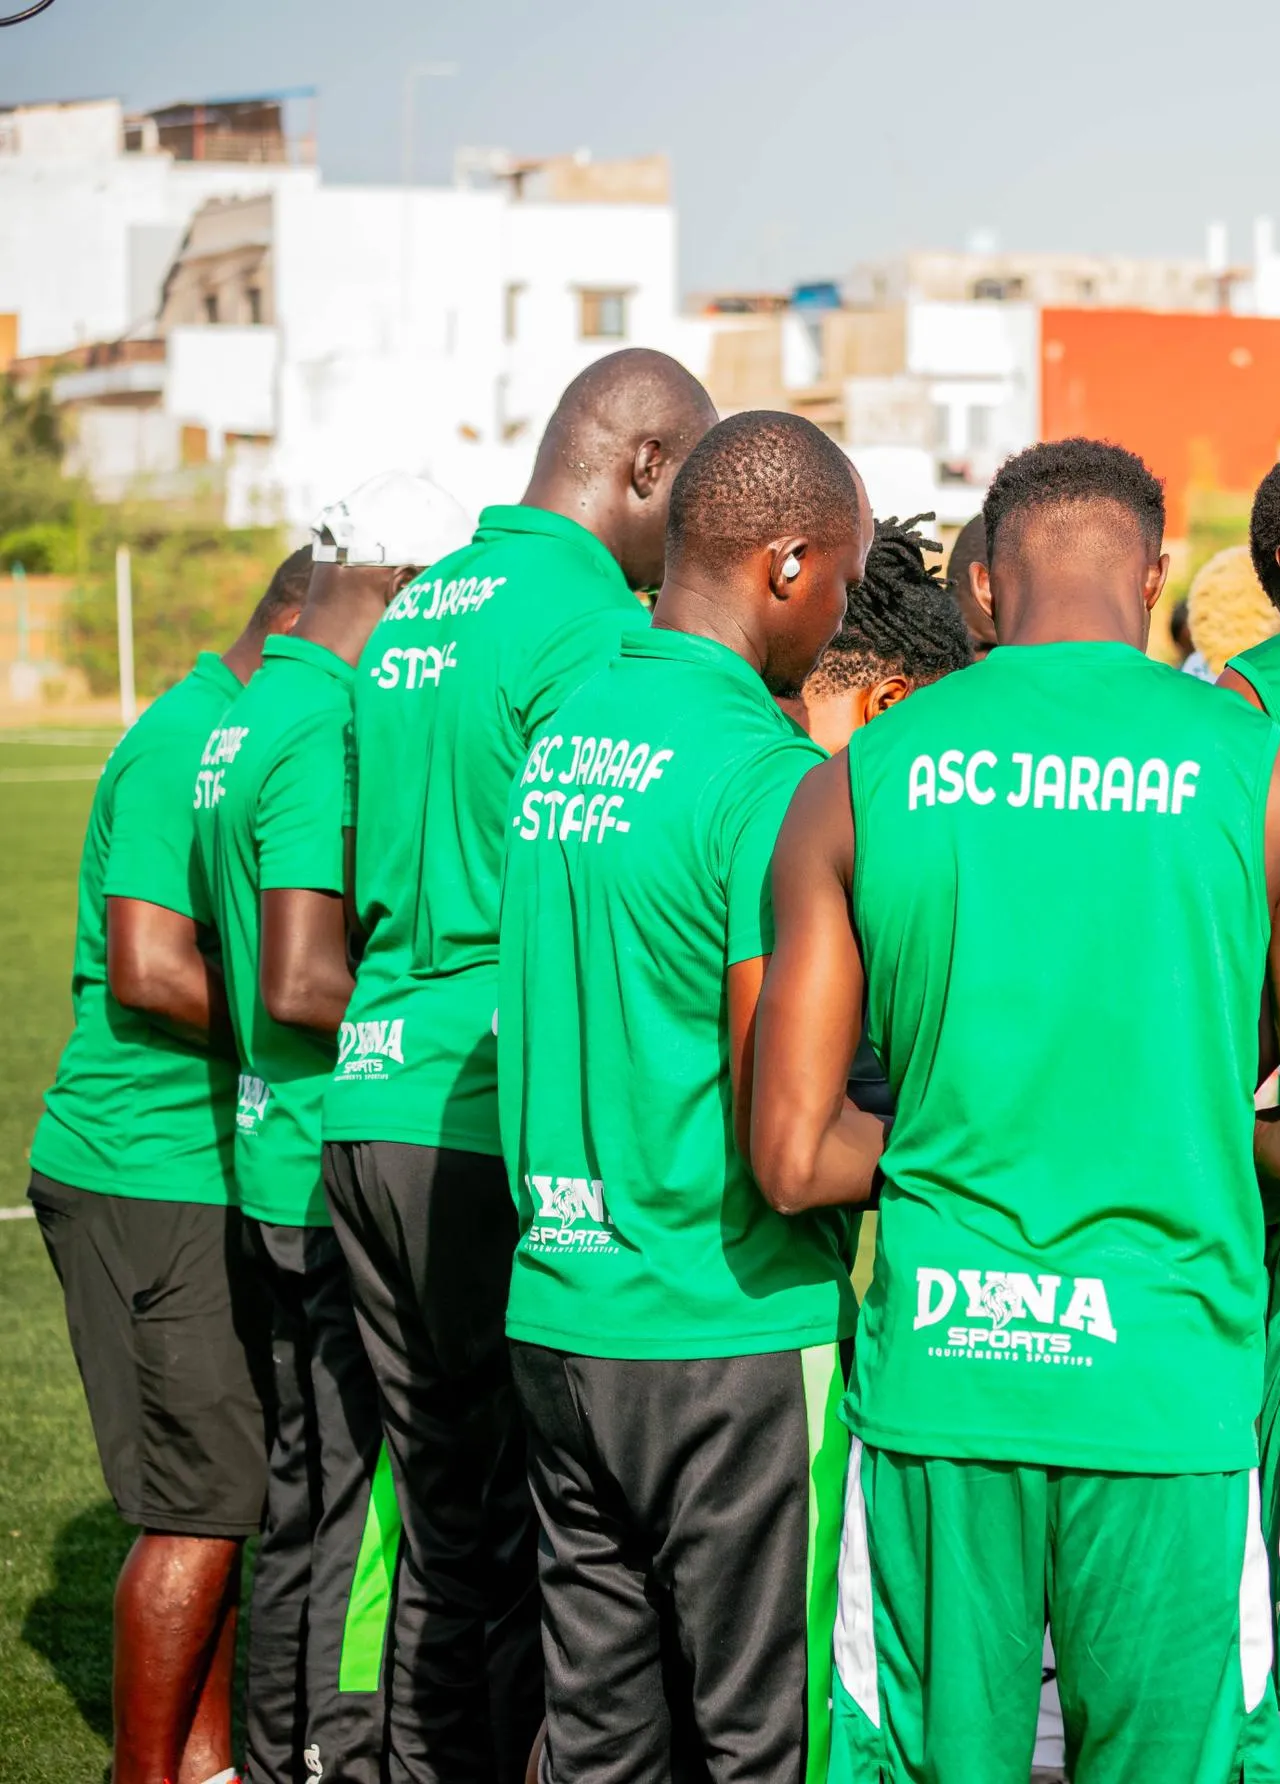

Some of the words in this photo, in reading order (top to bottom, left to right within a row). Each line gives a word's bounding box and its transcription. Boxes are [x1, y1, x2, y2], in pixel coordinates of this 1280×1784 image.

[558, 735, 674, 793] JARAAF
[909, 750, 997, 811] ASC
[1007, 753, 1200, 815] JARAAF
[524, 1174, 616, 1225] YN
[528, 1225, 612, 1246] SPORTS
[913, 1266, 1118, 1345] DYNA
[928, 1346, 1019, 1363] EQUIPEMENTS
[1026, 1352, 1093, 1368] SPORTIFS
[947, 1326, 1072, 1354] SPORTS
